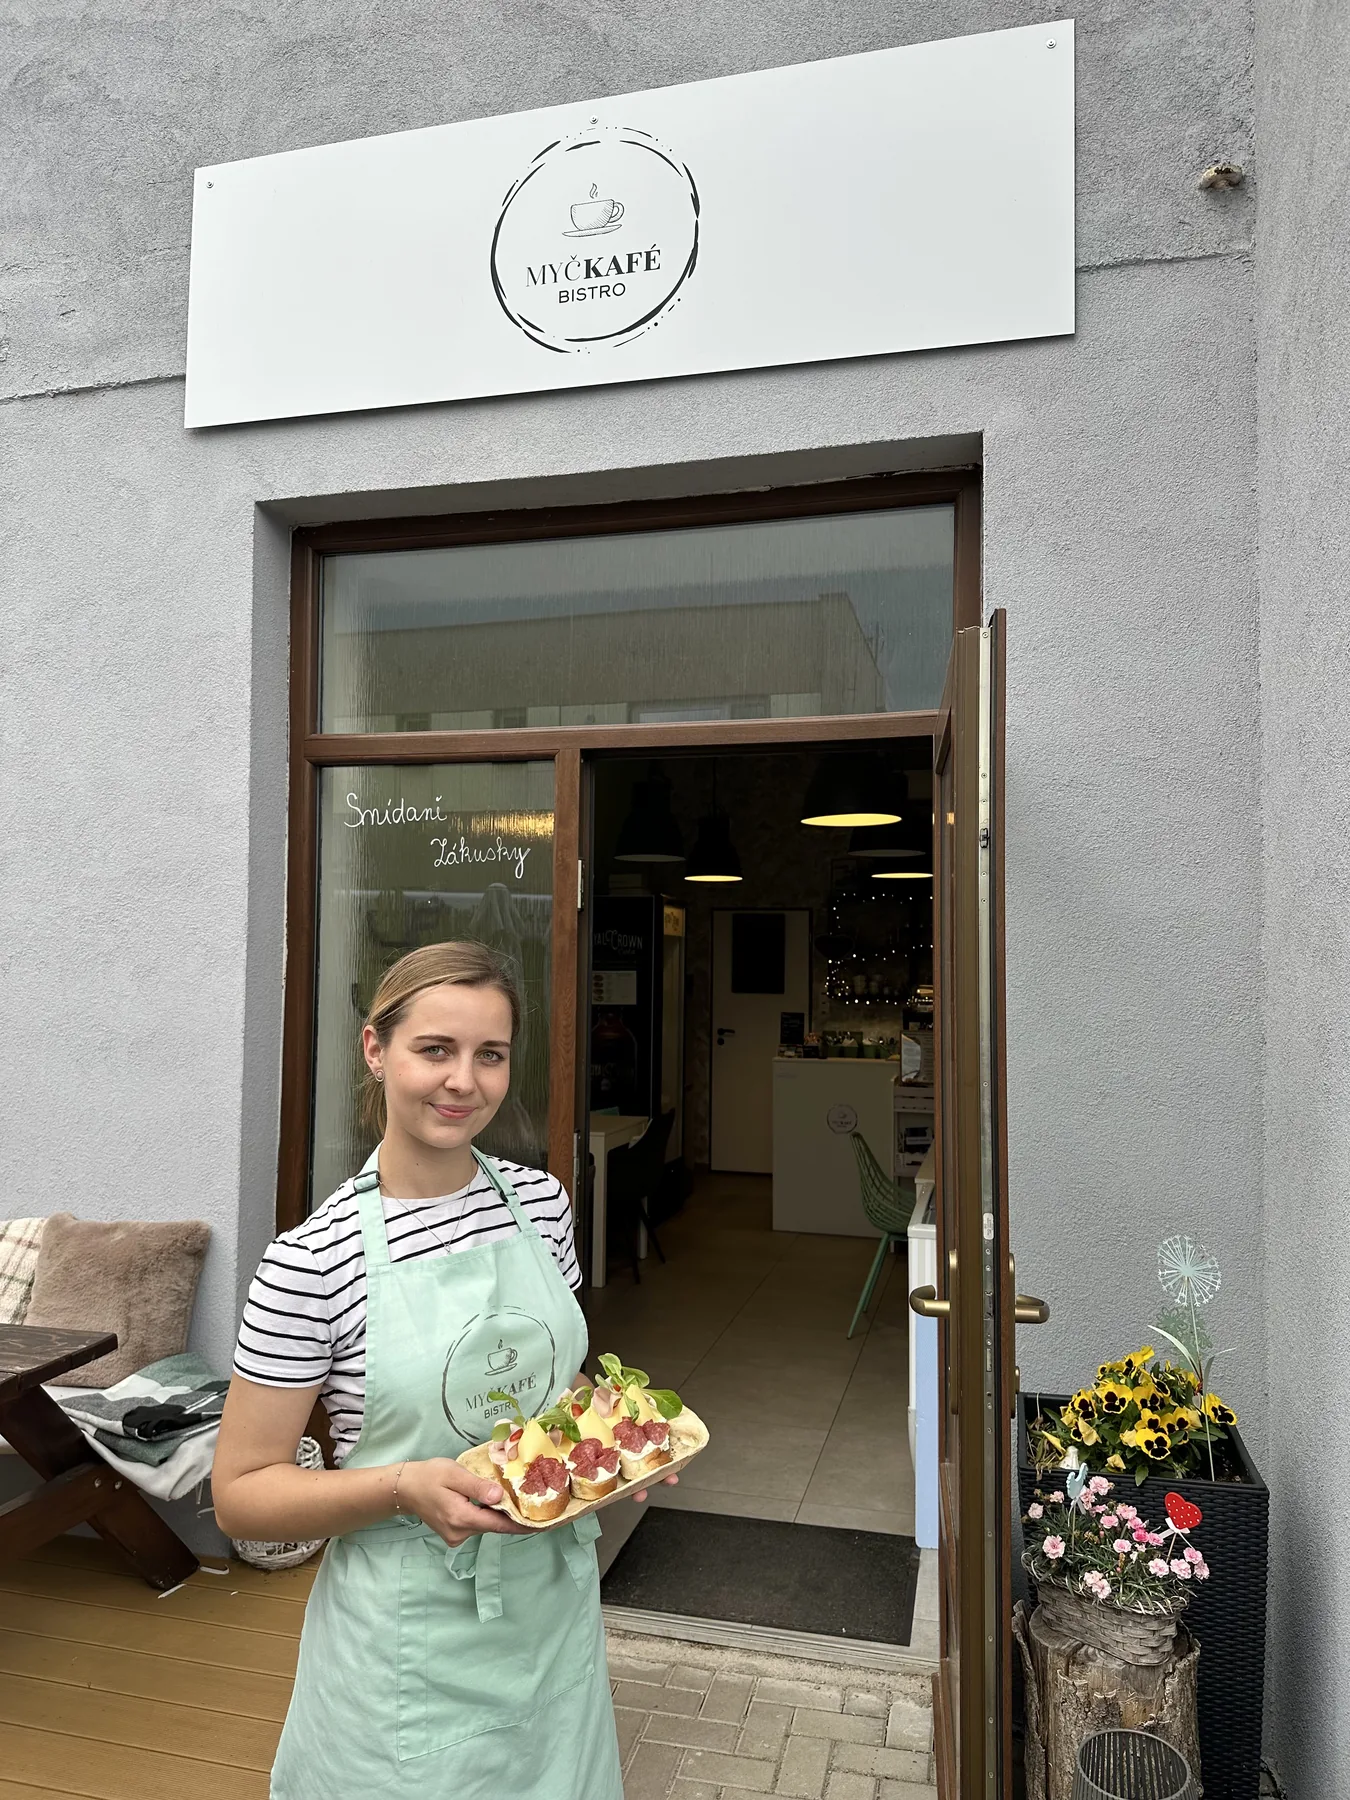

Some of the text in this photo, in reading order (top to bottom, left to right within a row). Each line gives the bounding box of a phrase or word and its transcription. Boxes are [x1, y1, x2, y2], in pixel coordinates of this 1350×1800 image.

[526, 243, 661, 287] MYČKAFÉ
[558, 283, 626, 303] BISTRO
[430, 836, 531, 879] Zákusky
[593, 933, 608, 947] YAL
